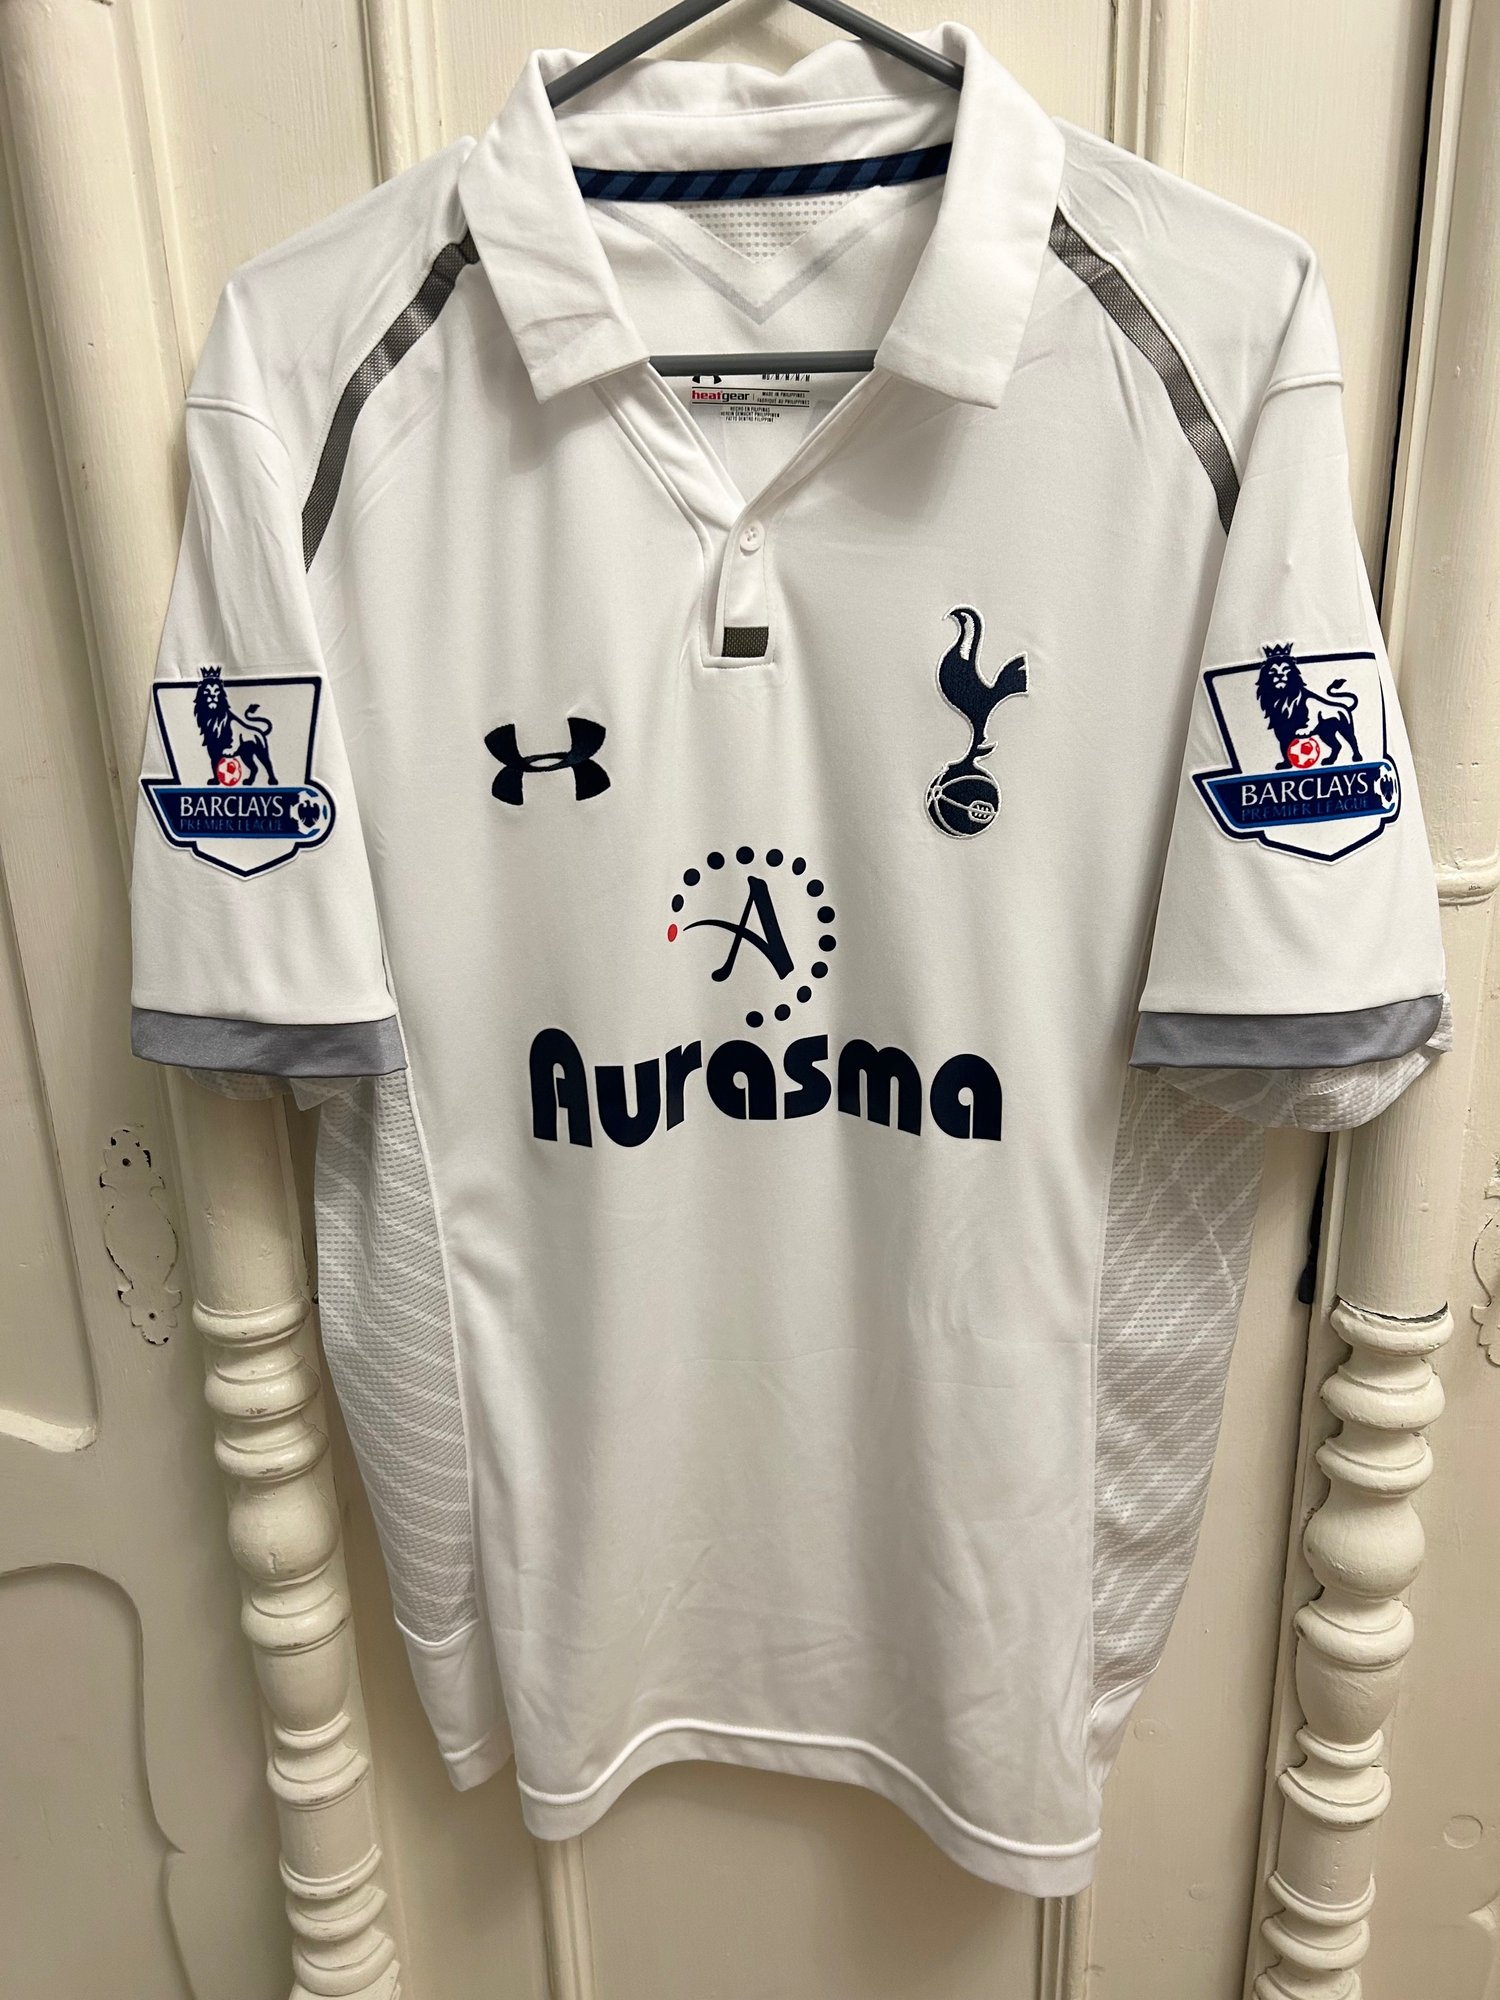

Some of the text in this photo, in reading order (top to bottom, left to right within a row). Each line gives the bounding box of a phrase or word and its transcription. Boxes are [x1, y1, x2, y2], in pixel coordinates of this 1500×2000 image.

[1241, 772, 1369, 807] BARCLAYS
[180, 795, 284, 817] BARCLAYS
[1241, 795, 1369, 821] PREMIER LEAGUE
[180, 818, 284, 832] PREMIER LEAGUE
[529, 1027, 1003, 1148] Aurasma
